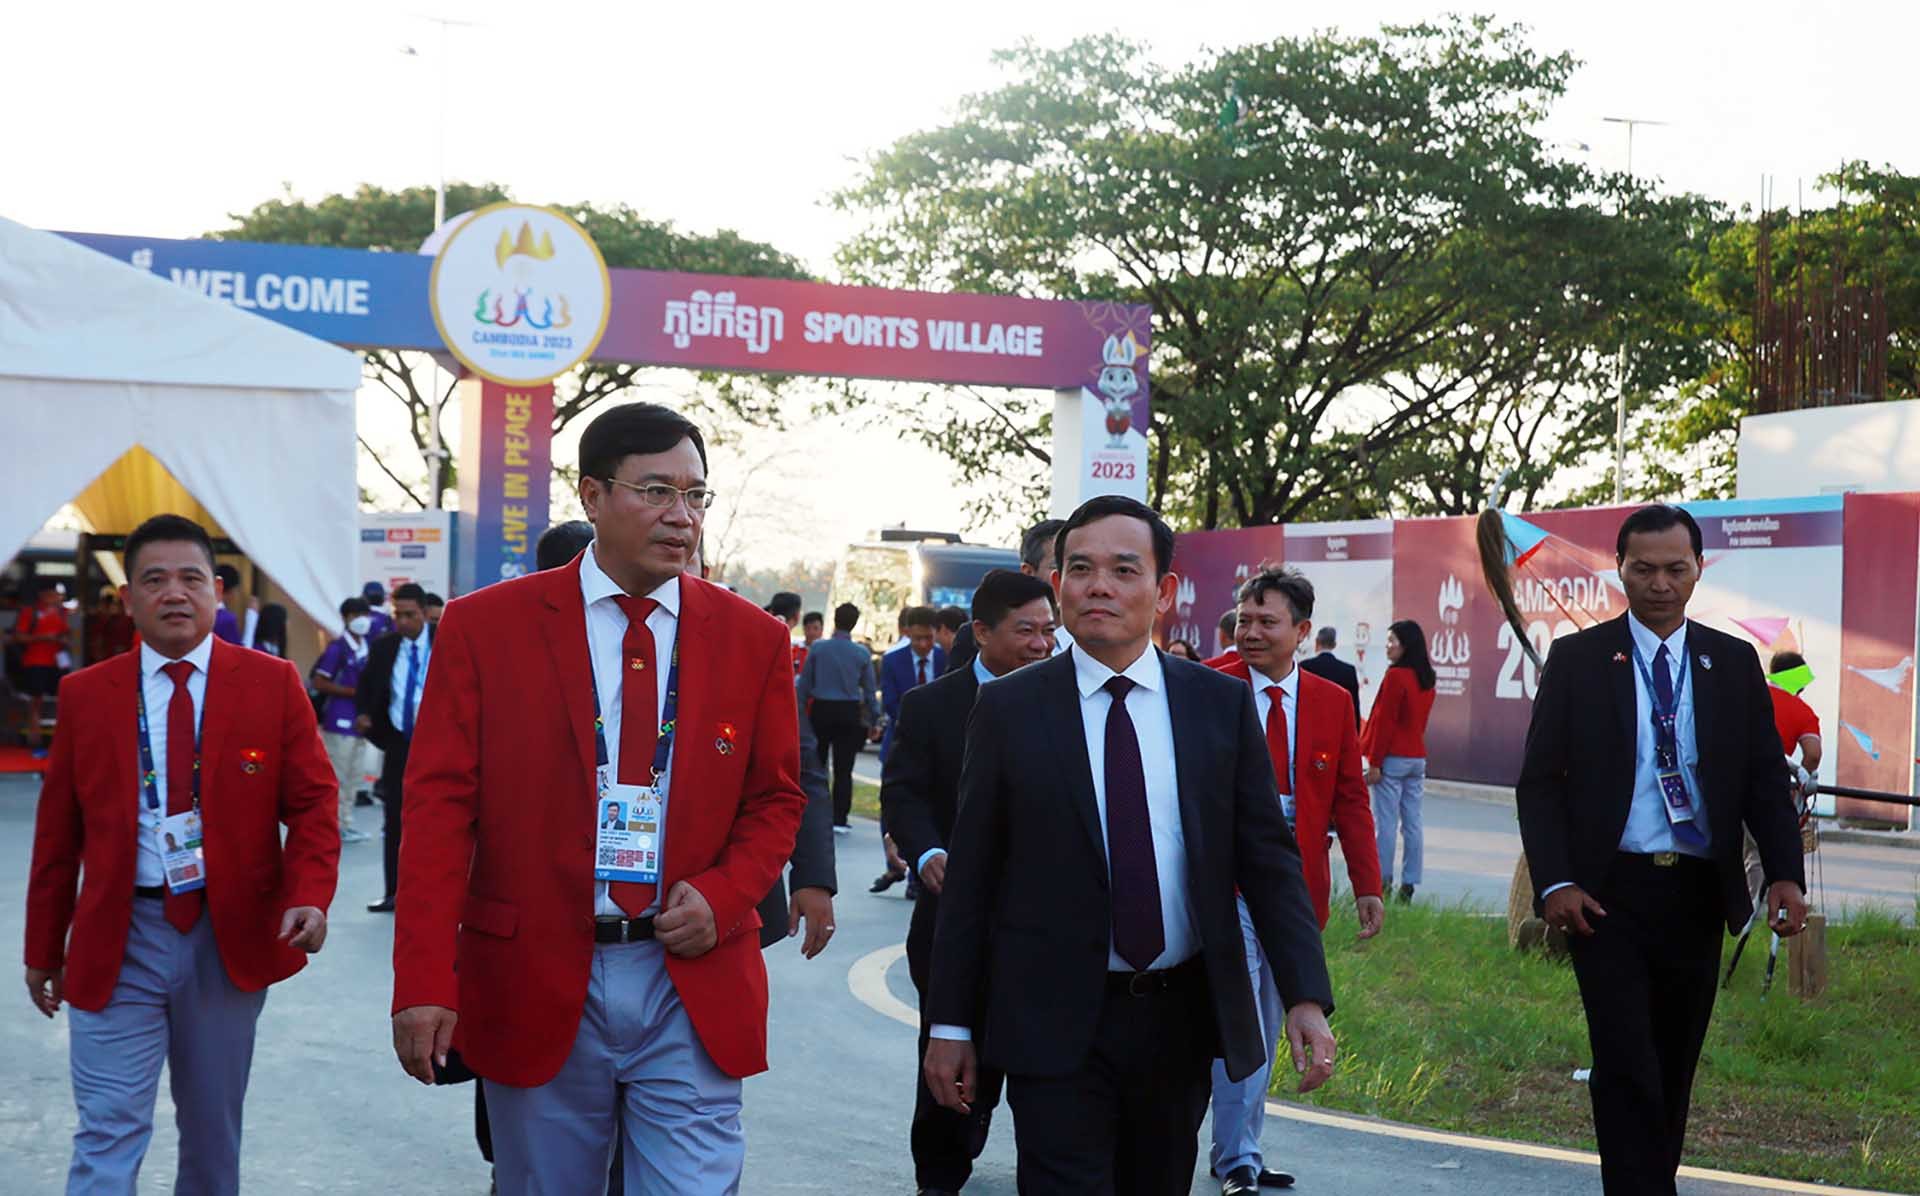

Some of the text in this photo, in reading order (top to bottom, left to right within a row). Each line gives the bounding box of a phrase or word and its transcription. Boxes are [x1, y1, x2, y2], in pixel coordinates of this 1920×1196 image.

[169, 267, 370, 315] WELCOME
[663, 289, 785, 354] ភូមិកីឡា
[803, 311, 1043, 357] SPORTS VILLAGE
[505, 392, 531, 467] PEACE
[504, 472, 529, 498] IN
[1091, 461, 1136, 481] 2023
[503, 504, 529, 554] LIVE
[1512, 576, 1611, 613] AMBODIA
